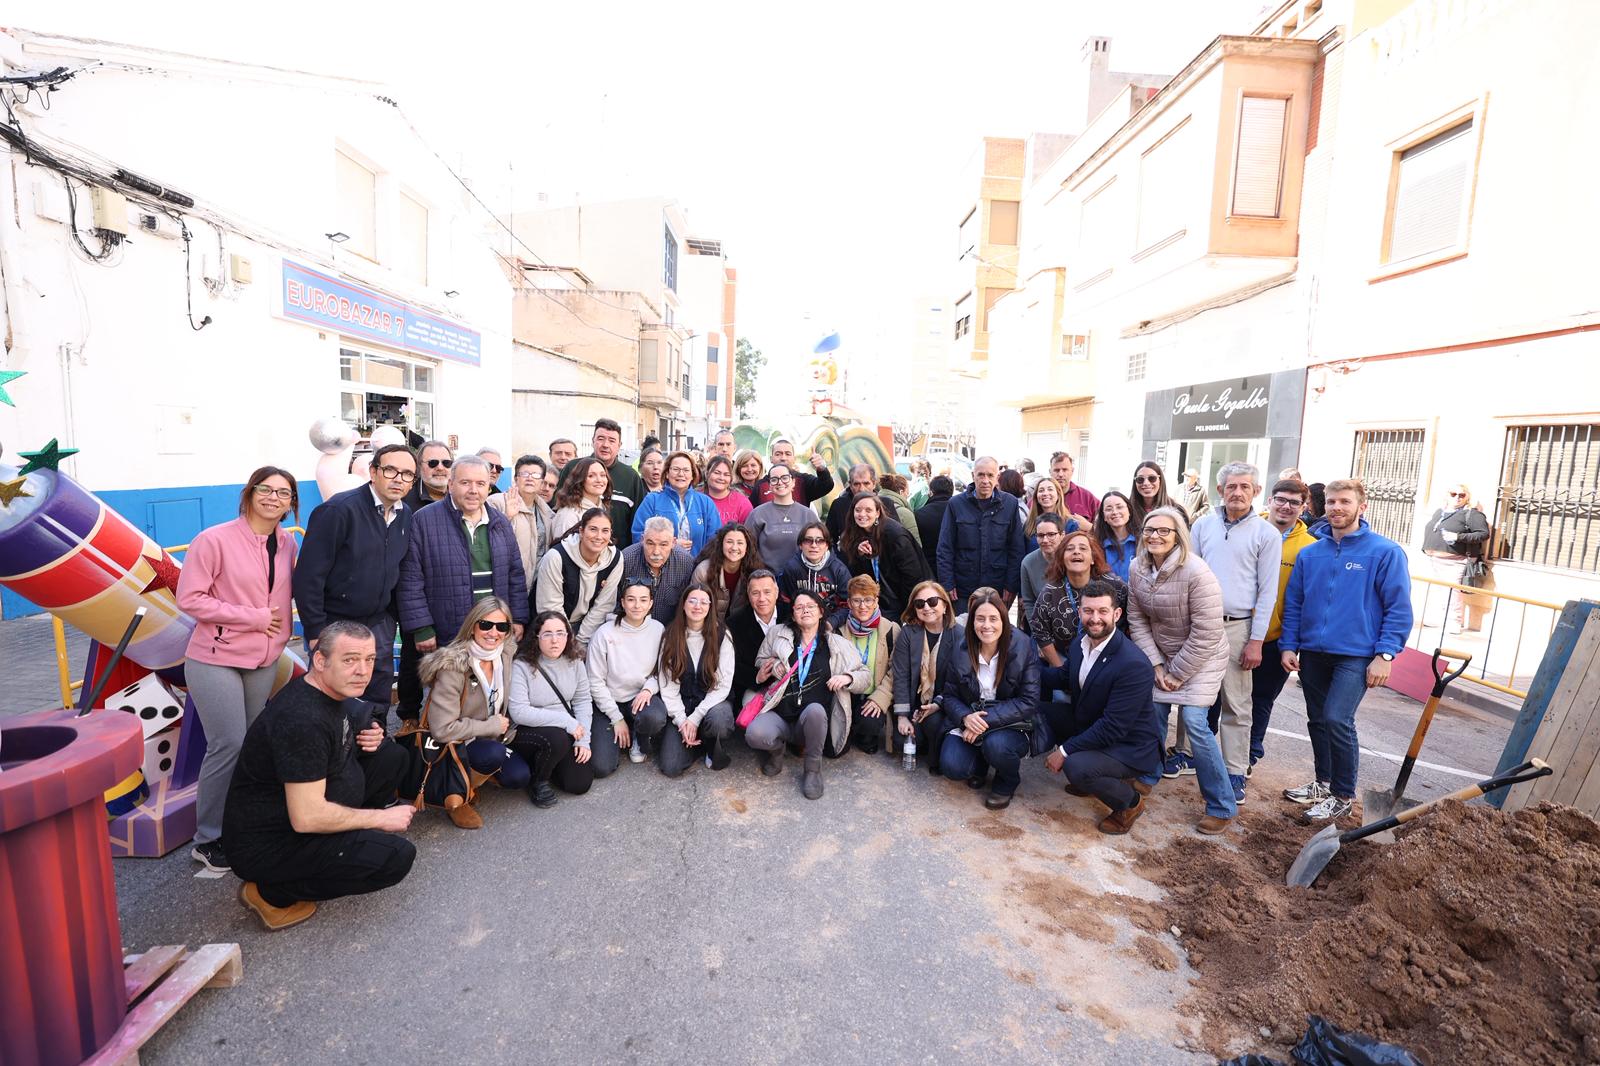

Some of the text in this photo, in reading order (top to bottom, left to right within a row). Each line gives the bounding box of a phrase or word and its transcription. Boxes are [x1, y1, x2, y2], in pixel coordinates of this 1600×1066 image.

[287, 278, 392, 334] EUROBAZAR
[395, 315, 405, 337] 7
[1172, 387, 1269, 419] Paula Gogalbo
